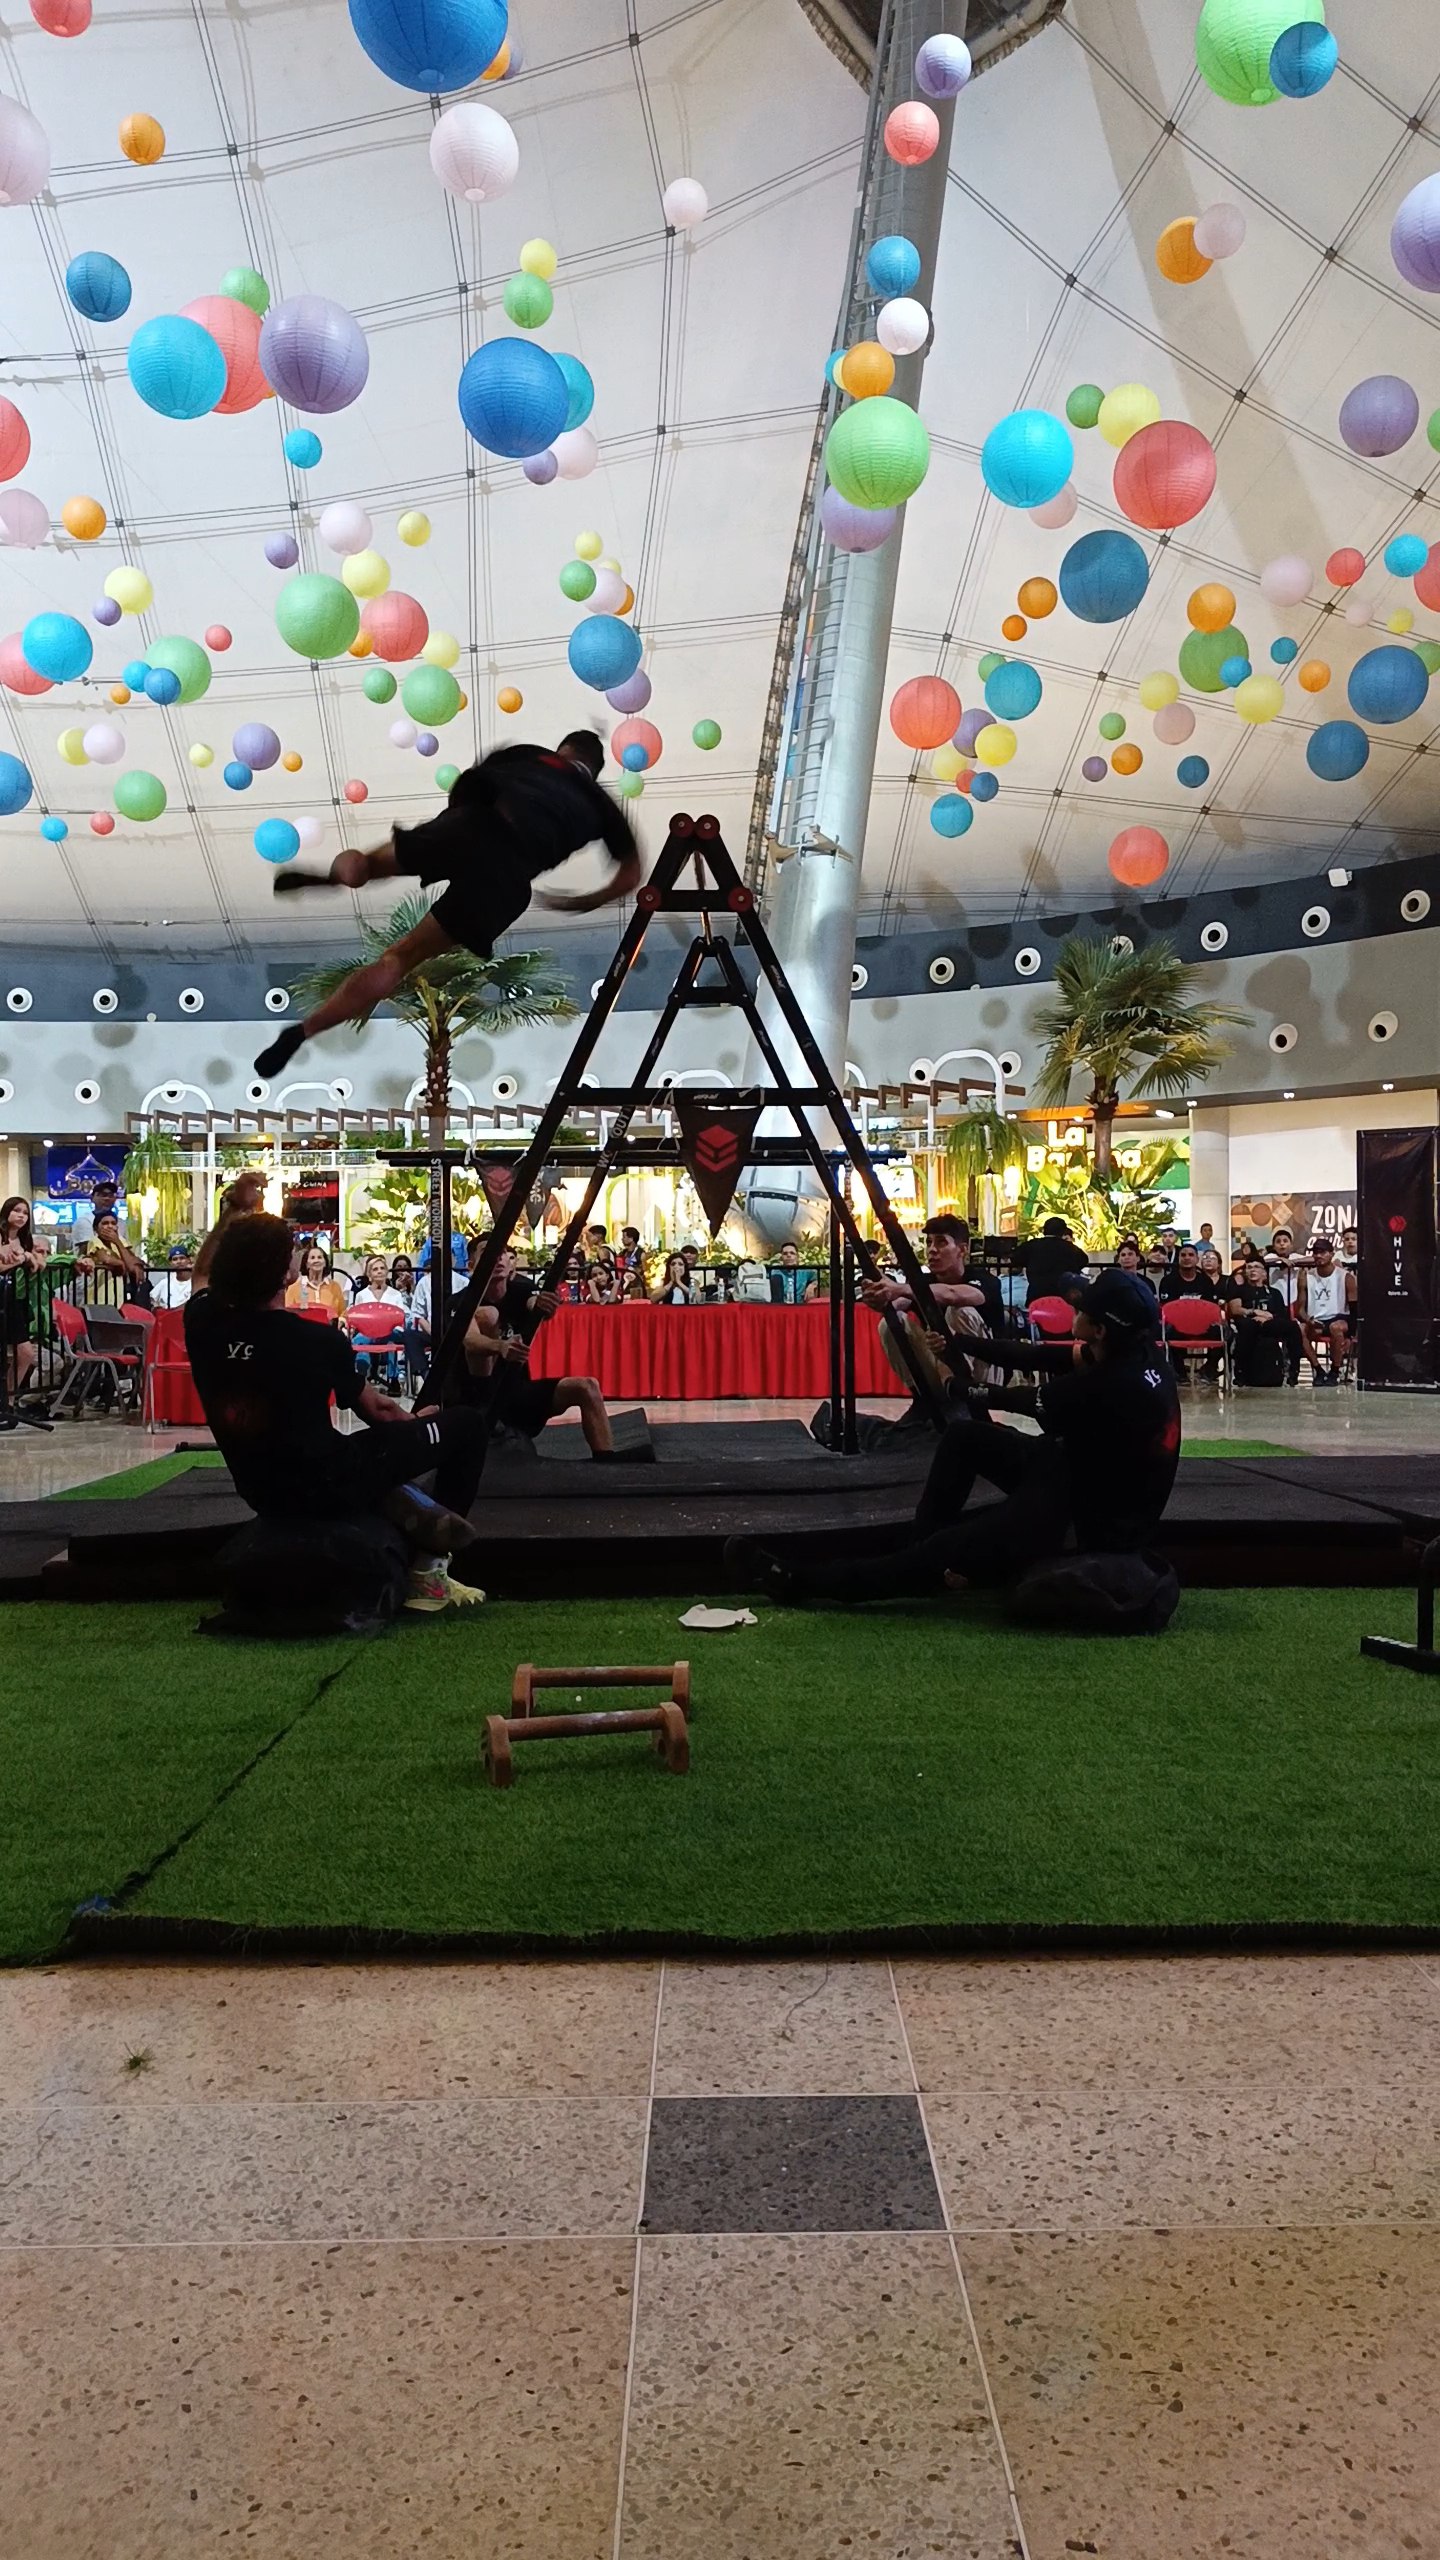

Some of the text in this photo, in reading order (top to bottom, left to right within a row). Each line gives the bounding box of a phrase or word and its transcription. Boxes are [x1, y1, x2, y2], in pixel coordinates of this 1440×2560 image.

[1047, 1120, 1086, 1148] La
[1026, 1145, 1142, 1172] Bana
[431, 1157, 442, 1249] STREET WORKOUT
[1393, 1235, 1403, 1287] HIVE
